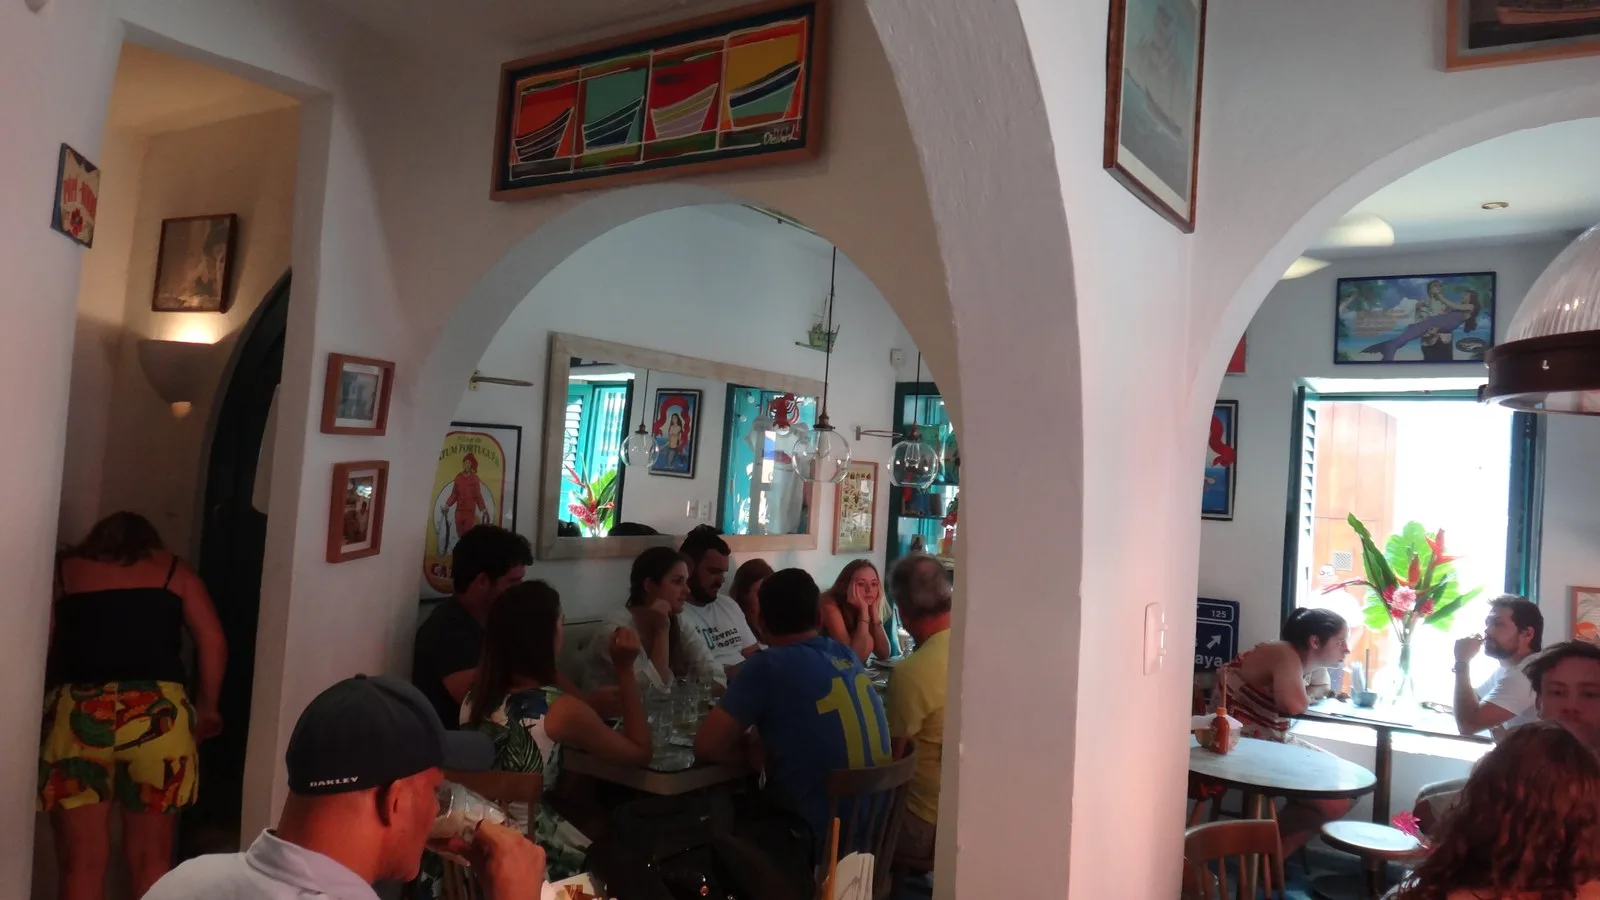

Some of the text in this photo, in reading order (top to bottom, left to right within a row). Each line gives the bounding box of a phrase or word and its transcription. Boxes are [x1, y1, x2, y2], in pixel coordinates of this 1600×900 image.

[1211, 610, 1227, 618] 125
[1195, 653, 1223, 669] aya
[816, 673, 893, 770] 10
[309, 776, 359, 787] OAKLEY
